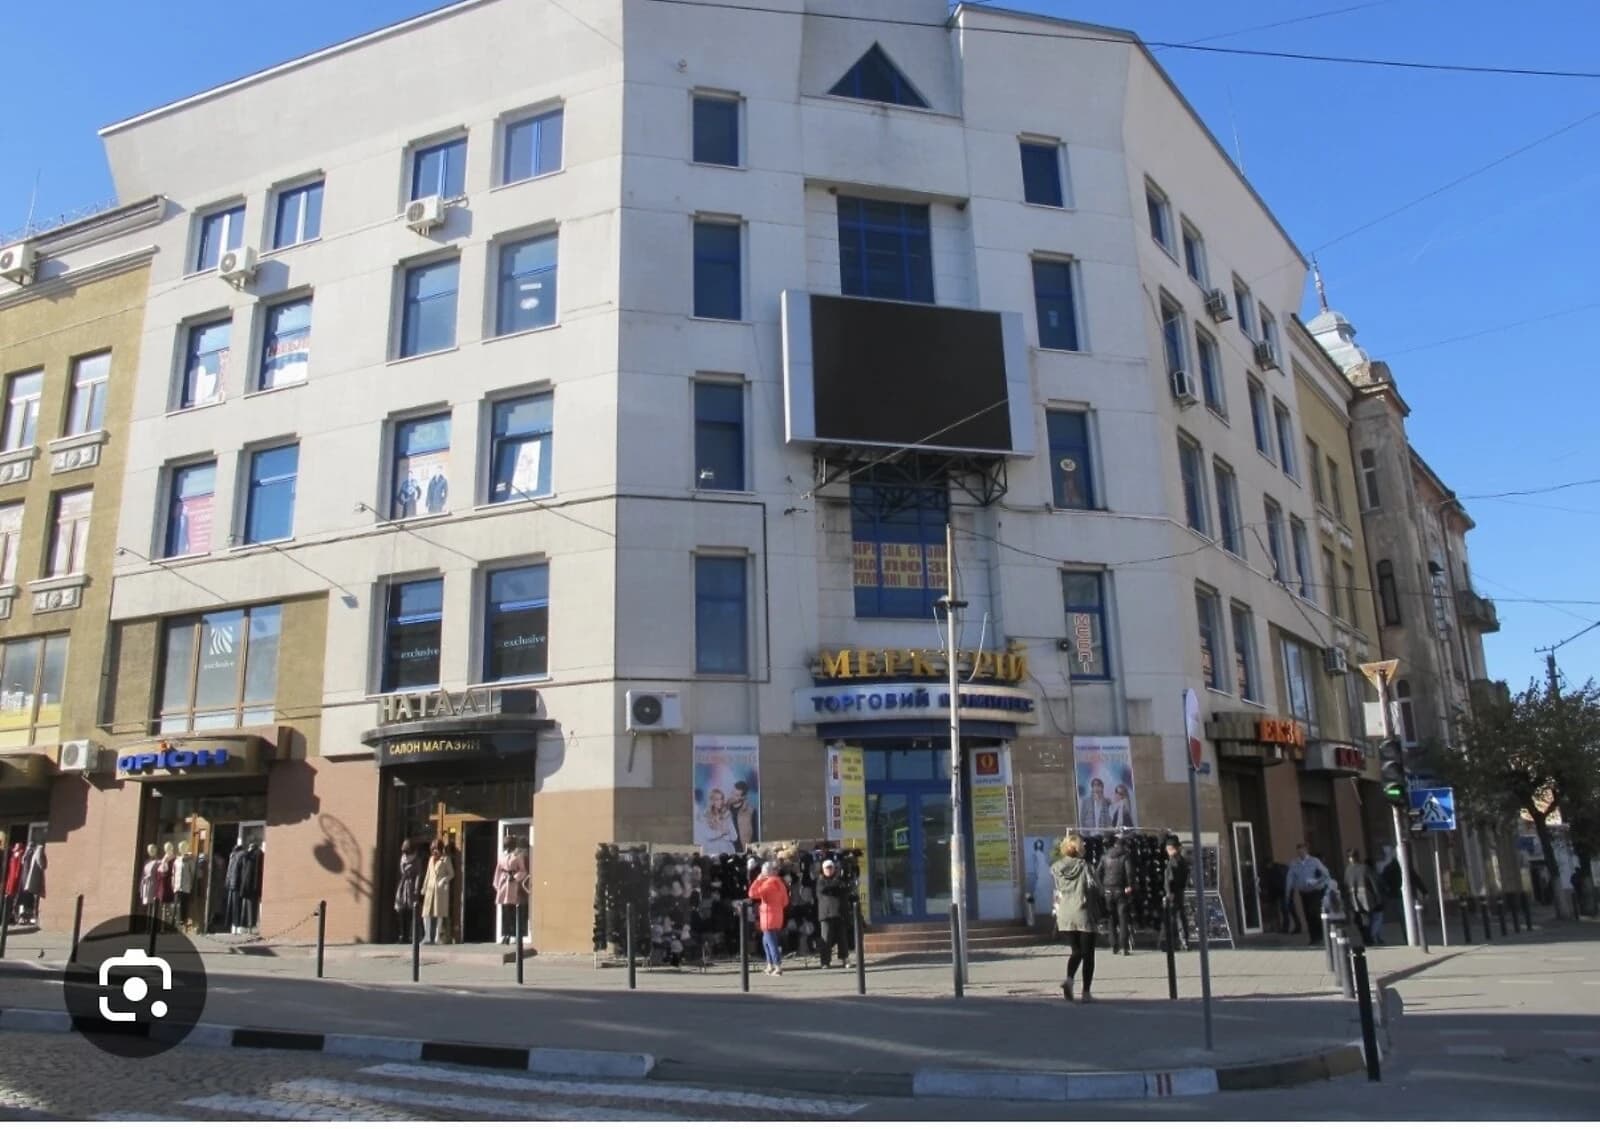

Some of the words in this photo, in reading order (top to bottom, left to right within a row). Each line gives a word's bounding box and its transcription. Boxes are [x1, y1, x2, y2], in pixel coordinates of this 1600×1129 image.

[503, 634, 545, 648] exclusive
[401, 646, 439, 658] exclusive
[811, 688, 930, 712] ТОРГОВИЙ
[389, 740, 420, 756] САЛОН
[423, 738, 480, 753] МАГАЗИН
[118, 748, 228, 771] ОРІОН
